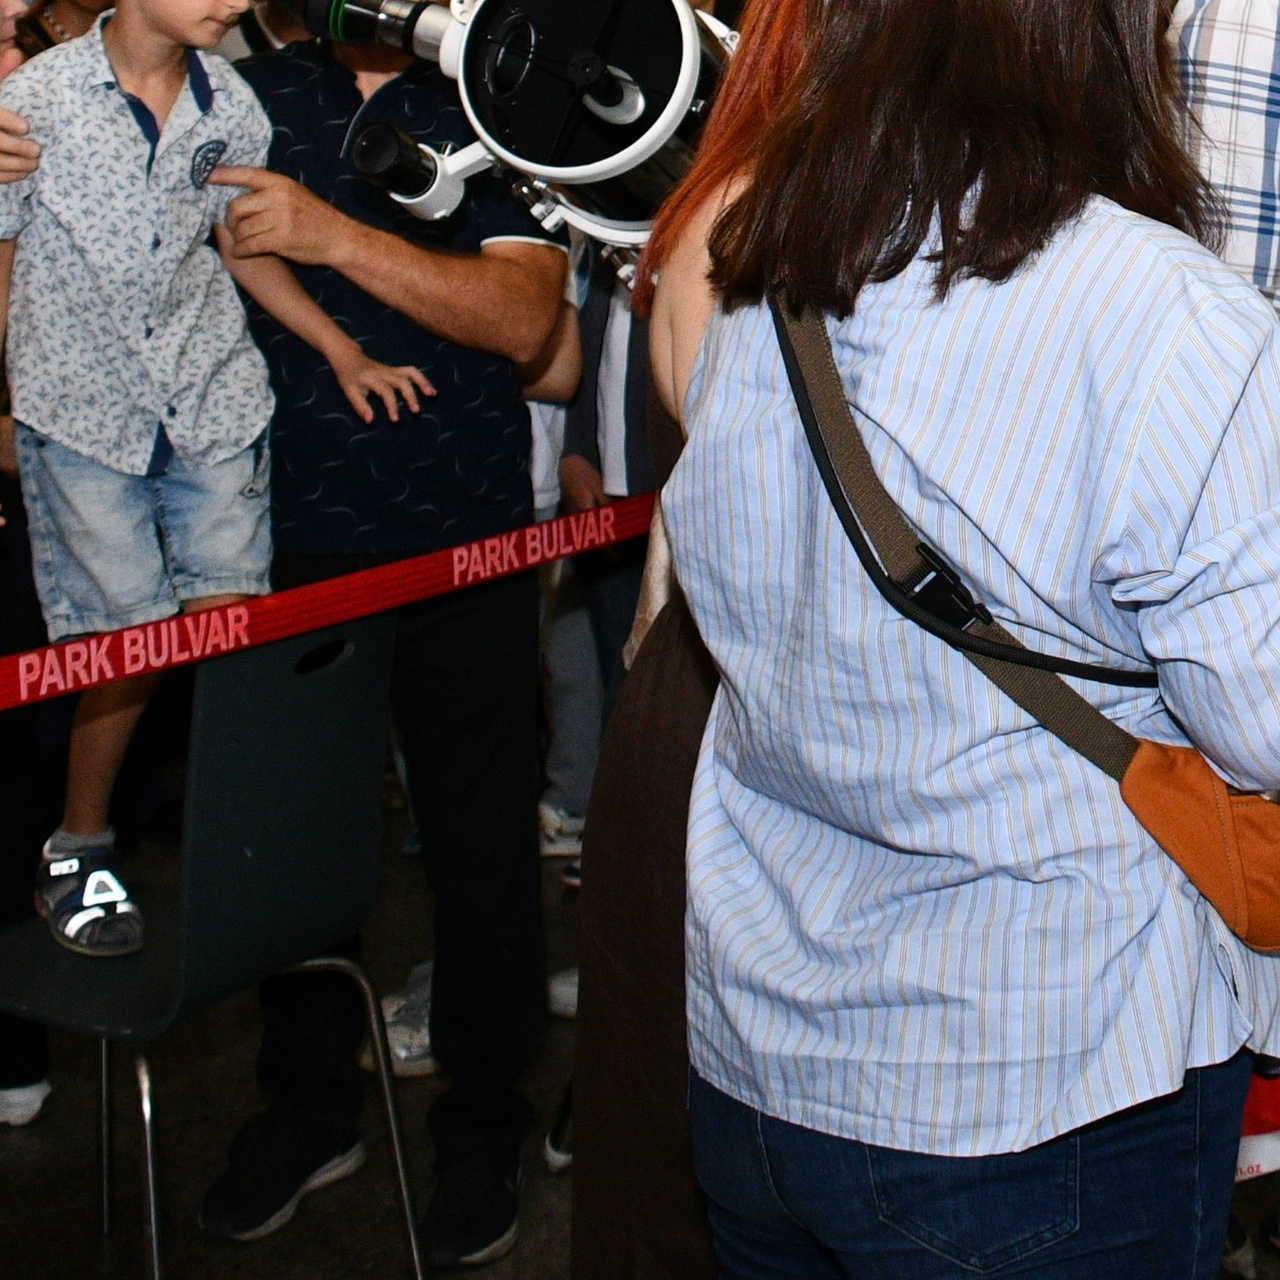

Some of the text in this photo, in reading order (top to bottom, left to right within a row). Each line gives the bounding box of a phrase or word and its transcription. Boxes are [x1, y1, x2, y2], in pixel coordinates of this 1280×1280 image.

[453, 507, 616, 586] PARK BULVAR
[18, 605, 249, 701] PARK BULVAR
